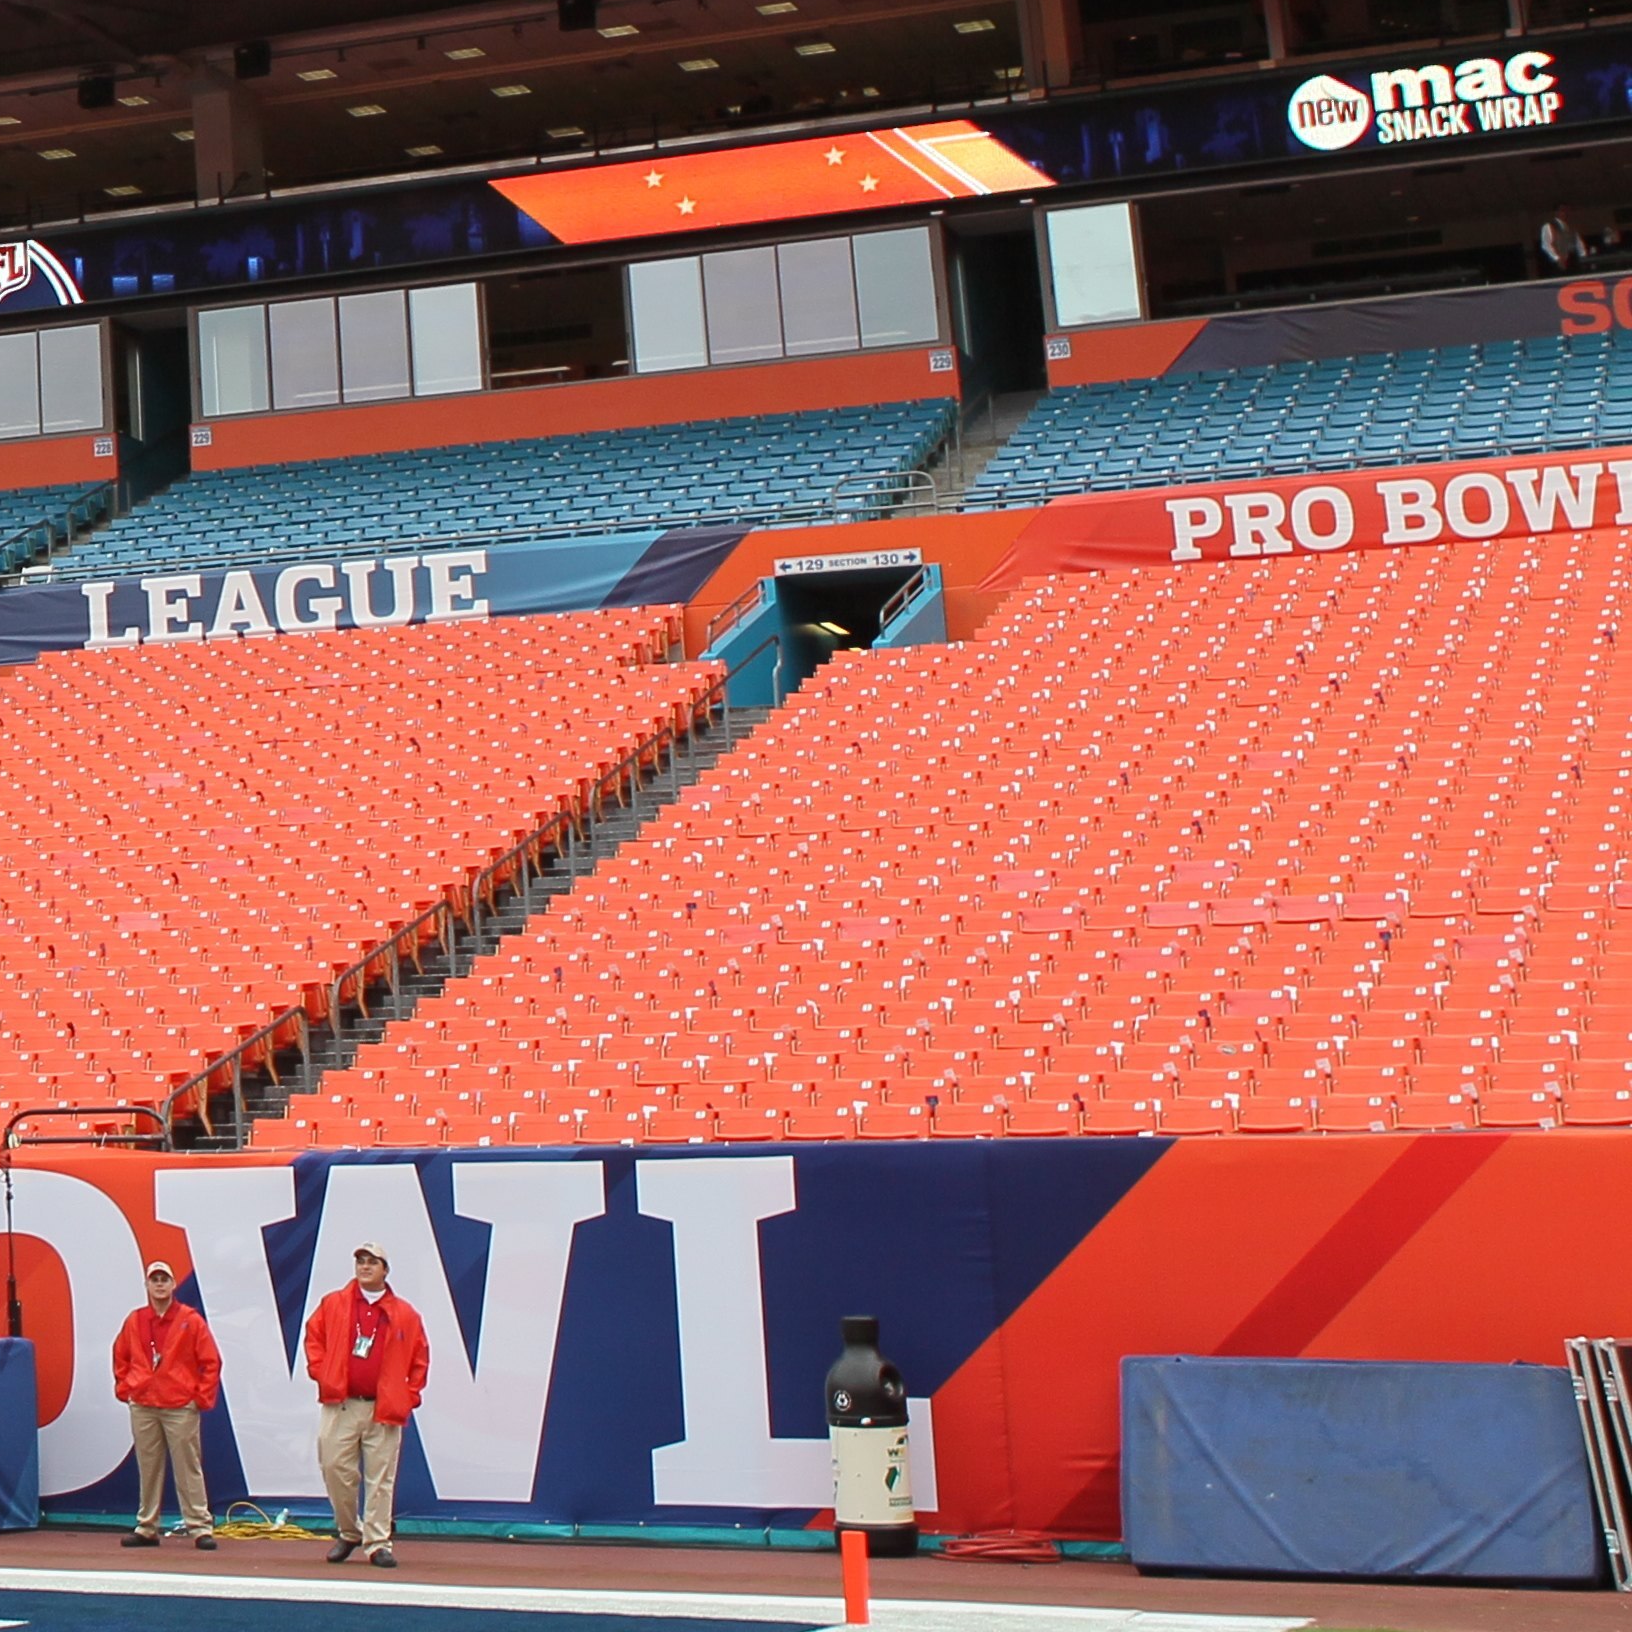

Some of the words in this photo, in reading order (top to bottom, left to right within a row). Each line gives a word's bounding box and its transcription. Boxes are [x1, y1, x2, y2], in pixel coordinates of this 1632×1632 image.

[1297, 94, 1363, 128] new
[1370, 51, 1557, 112] mac
[1375, 102, 1470, 145] SNACK
[1477, 92, 1561, 131] WRAP
[796, 559, 824, 572] 129
[829, 557, 868, 568] SECTION
[872, 552, 900, 566] 130
[1165, 485, 1356, 562] PRO
[82, 550, 490, 650] LEAGUE
